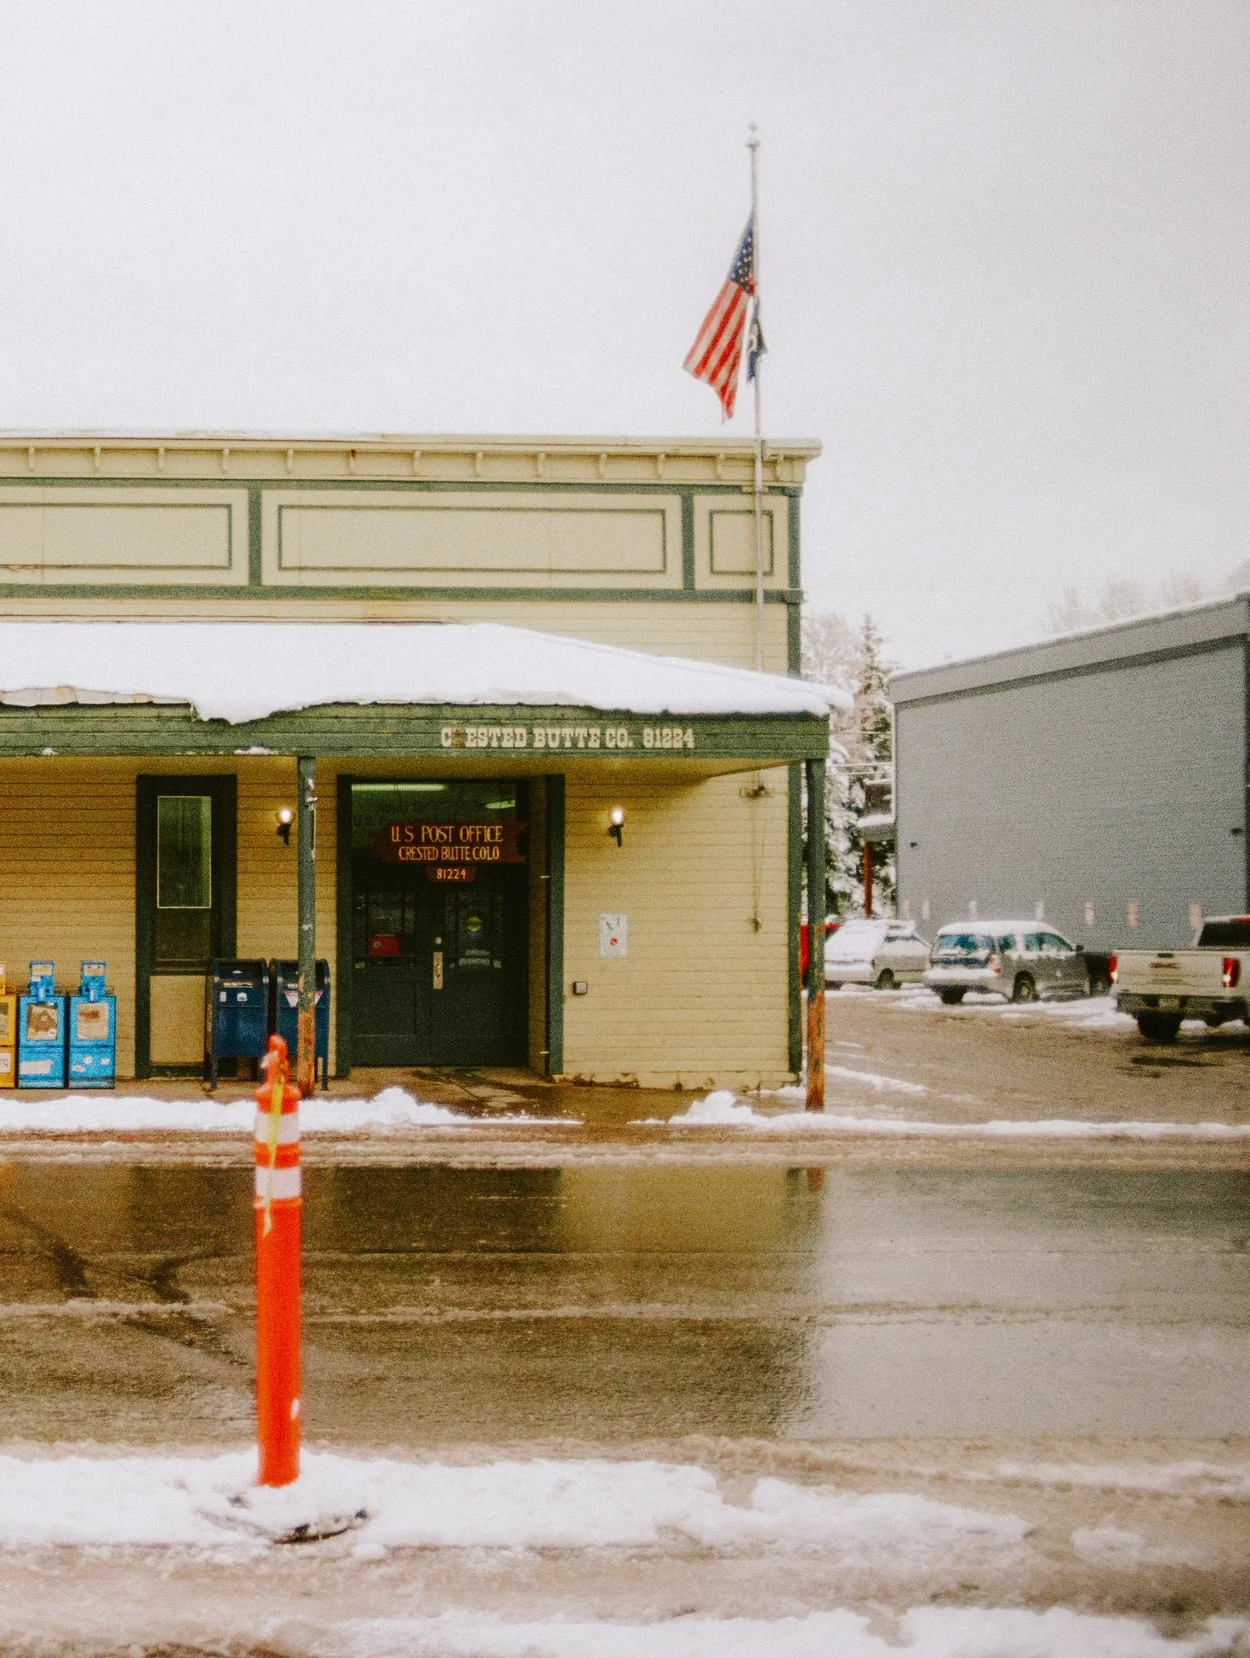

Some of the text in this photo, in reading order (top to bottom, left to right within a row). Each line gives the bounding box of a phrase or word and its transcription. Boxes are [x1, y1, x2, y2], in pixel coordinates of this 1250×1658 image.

[532, 727, 600, 748] BUTTE
[605, 727, 634, 748] CO.
[643, 728, 695, 748] 81224
[421, 825, 455, 843] POST
[459, 825, 503, 843] OFFICE
[398, 846, 439, 861] CRESTED
[441, 846, 470, 861] BUTTE
[436, 868, 467, 880] 81224
